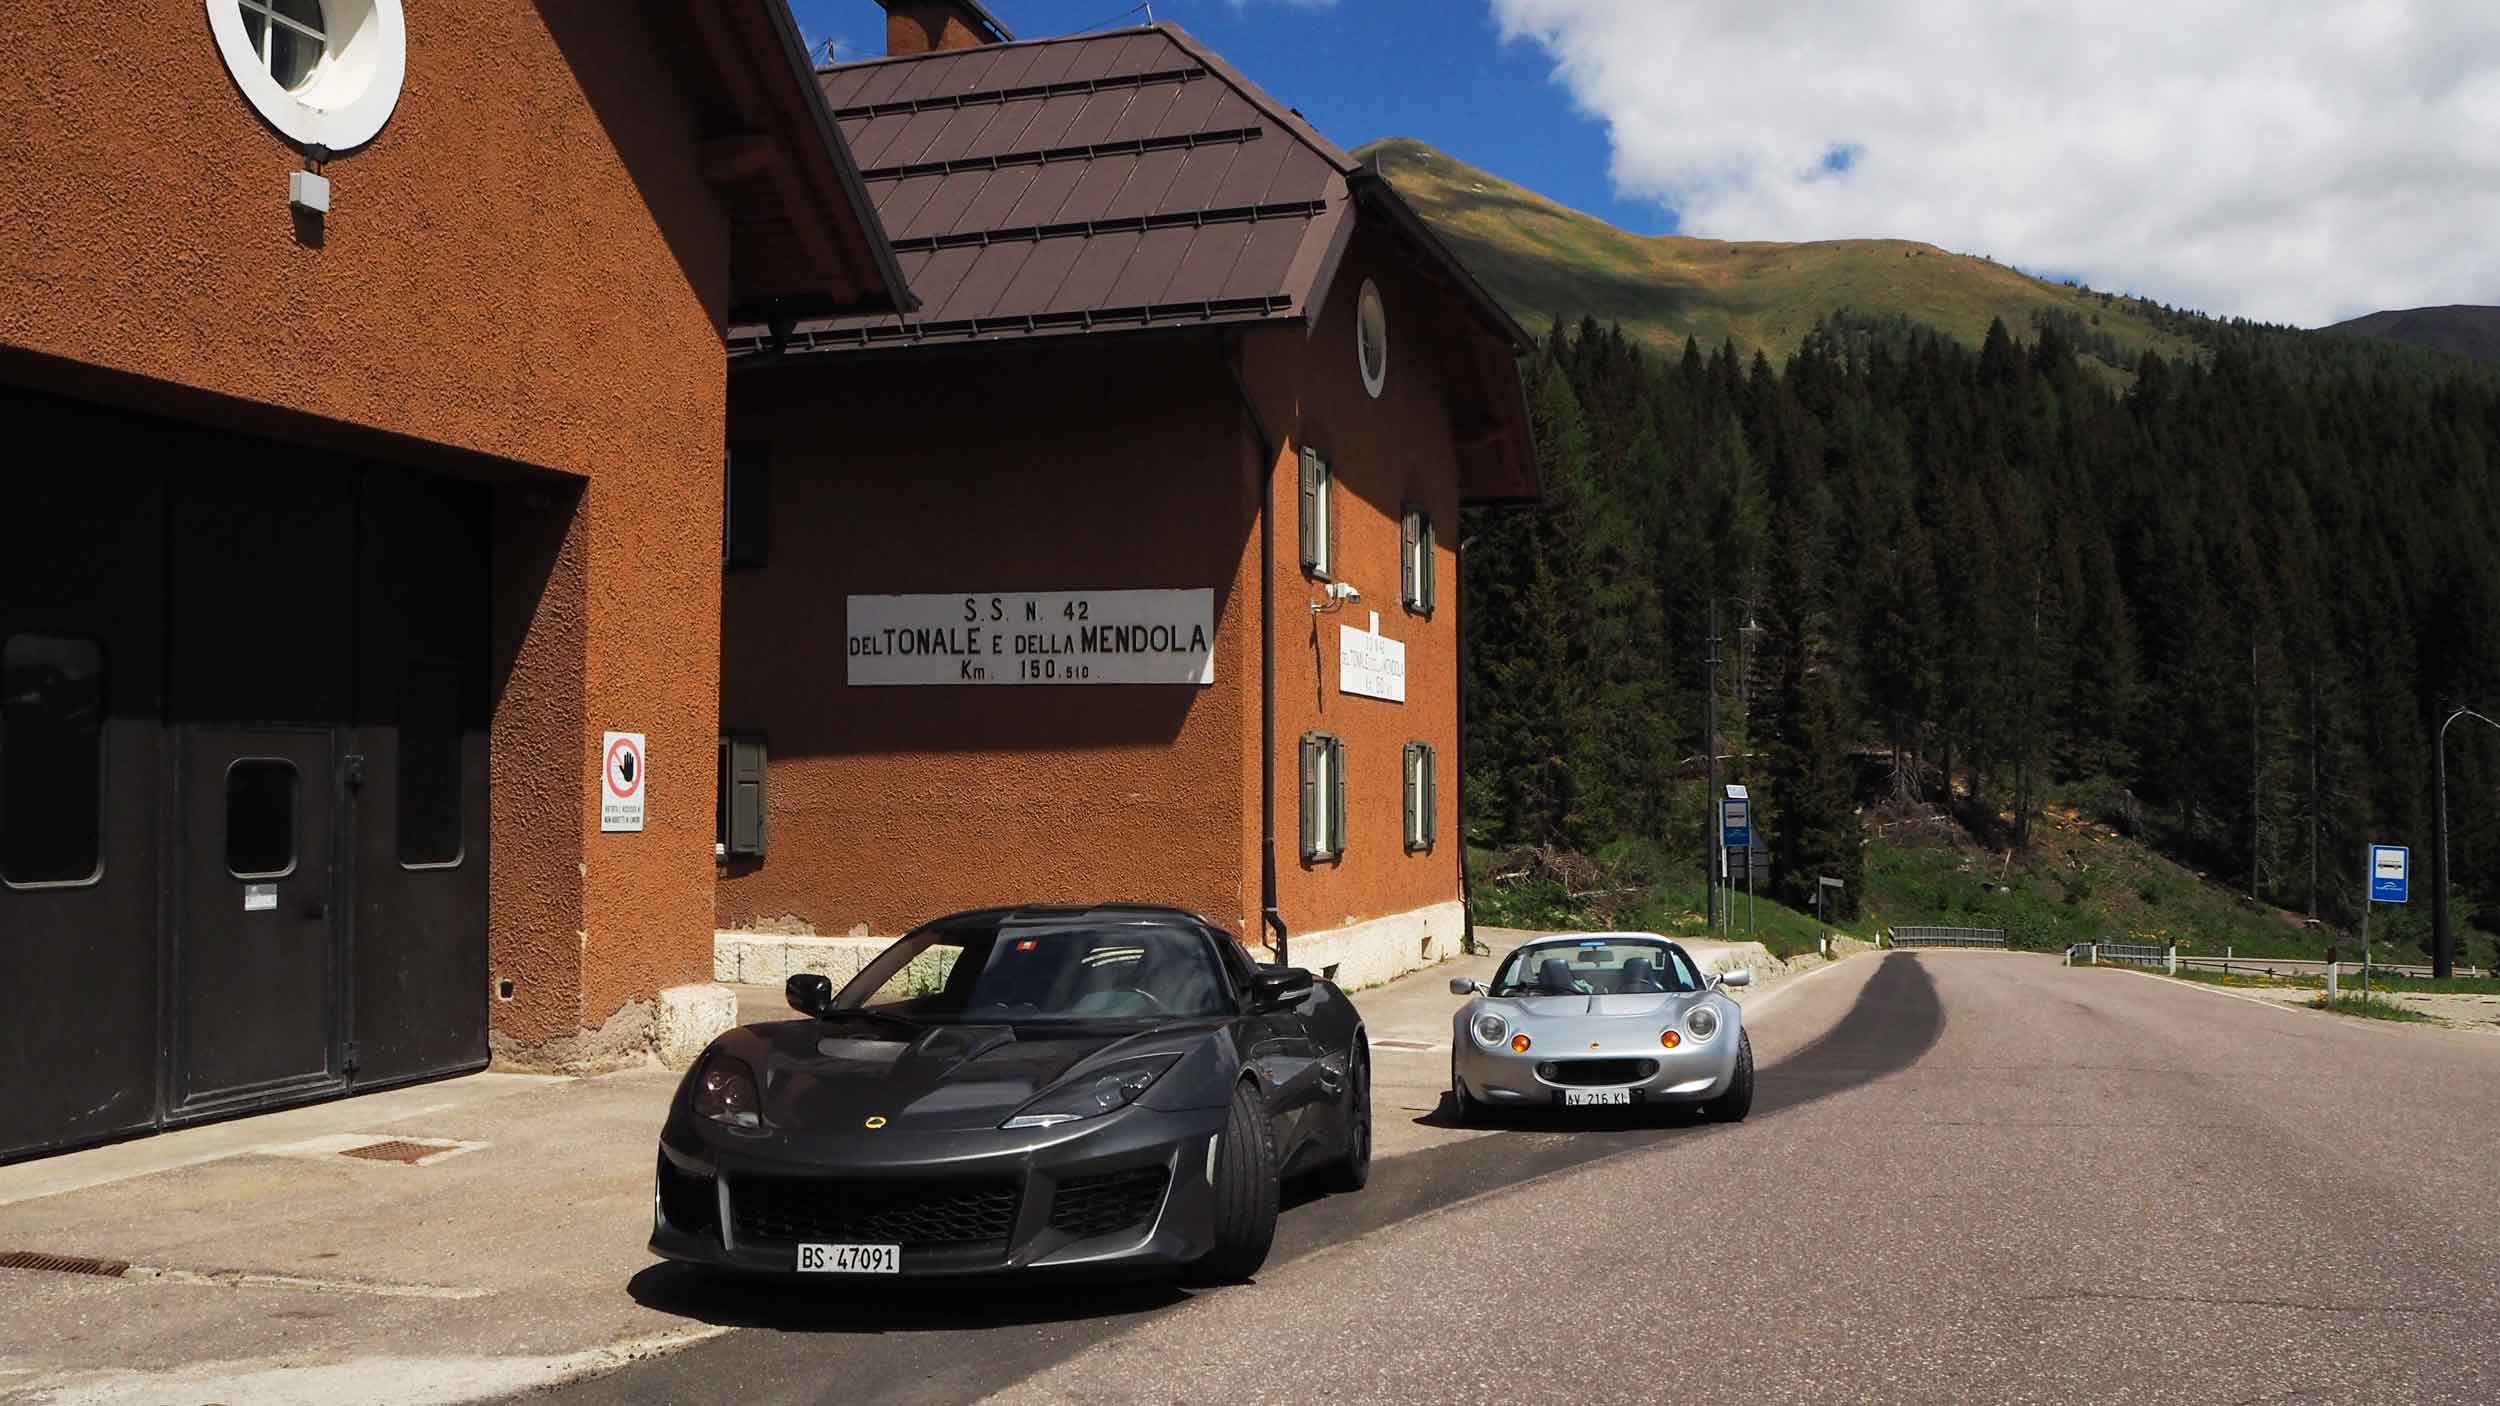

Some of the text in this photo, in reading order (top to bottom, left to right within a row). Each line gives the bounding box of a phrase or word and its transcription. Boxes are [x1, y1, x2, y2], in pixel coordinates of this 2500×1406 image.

[1063, 601, 1088, 621] 42
[992, 635, 1002, 654] E
[1015, 634, 1074, 654] DELLA
[1081, 624, 1207, 653] MENDOLA
[1588, 1093, 1608, 1104] 216
